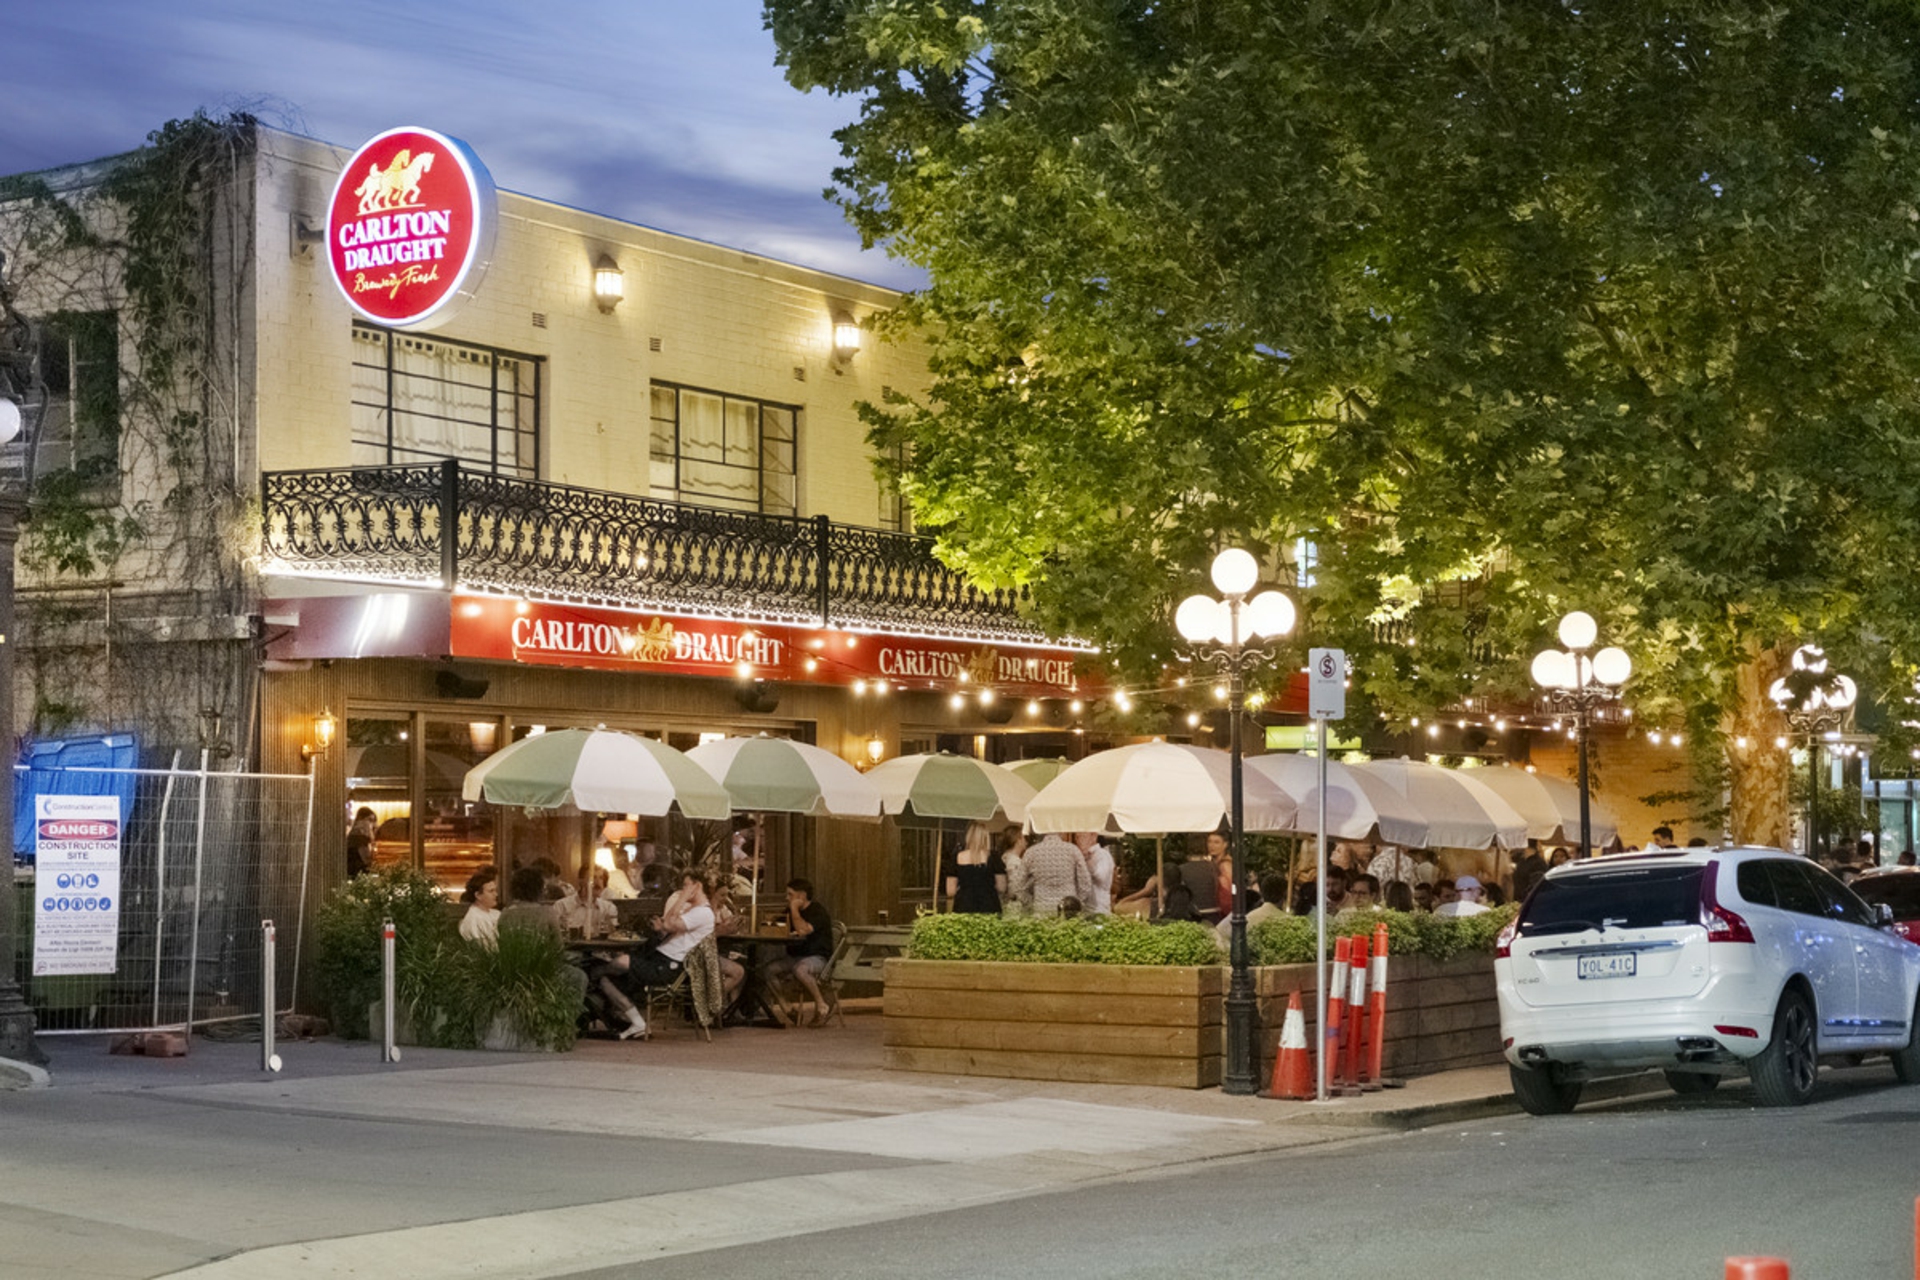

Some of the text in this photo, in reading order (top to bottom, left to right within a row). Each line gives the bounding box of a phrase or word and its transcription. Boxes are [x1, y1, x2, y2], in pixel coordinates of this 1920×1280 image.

[339, 210, 451, 248] CARLTON
[344, 237, 447, 271] DRAUGHT
[400, 264, 440, 286] Fresh
[511, 617, 785, 666] CARLTON DRAUGHT
[879, 647, 966, 679] CARLTON
[49, 824, 109, 836] DANGER
[38, 841, 118, 850] CONSTRUCTION
[67, 852, 89, 860] SITE
